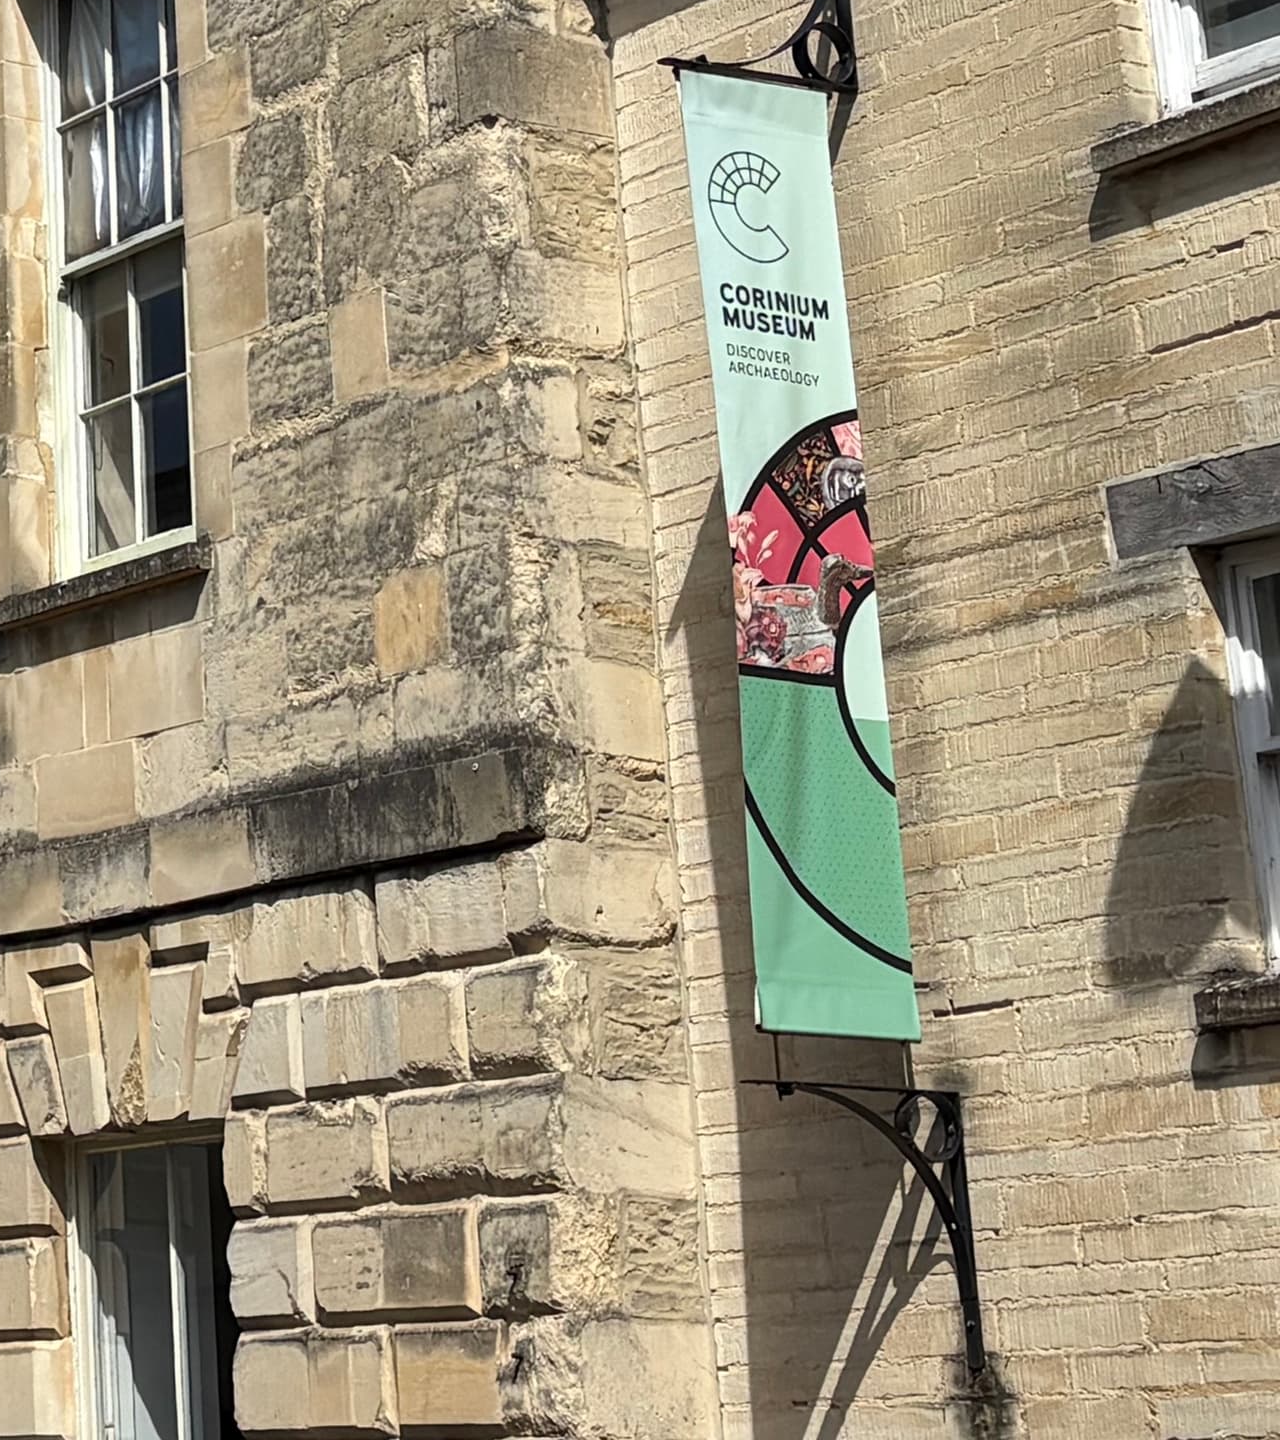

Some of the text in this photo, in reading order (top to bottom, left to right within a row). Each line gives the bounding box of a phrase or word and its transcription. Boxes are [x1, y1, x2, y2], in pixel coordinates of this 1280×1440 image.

[719, 282, 830, 320] CORINIUM
[722, 306, 816, 341] MUSEUM
[726, 343, 791, 365] DISCOVER
[729, 362, 820, 387] ARCHAEOLOGY
